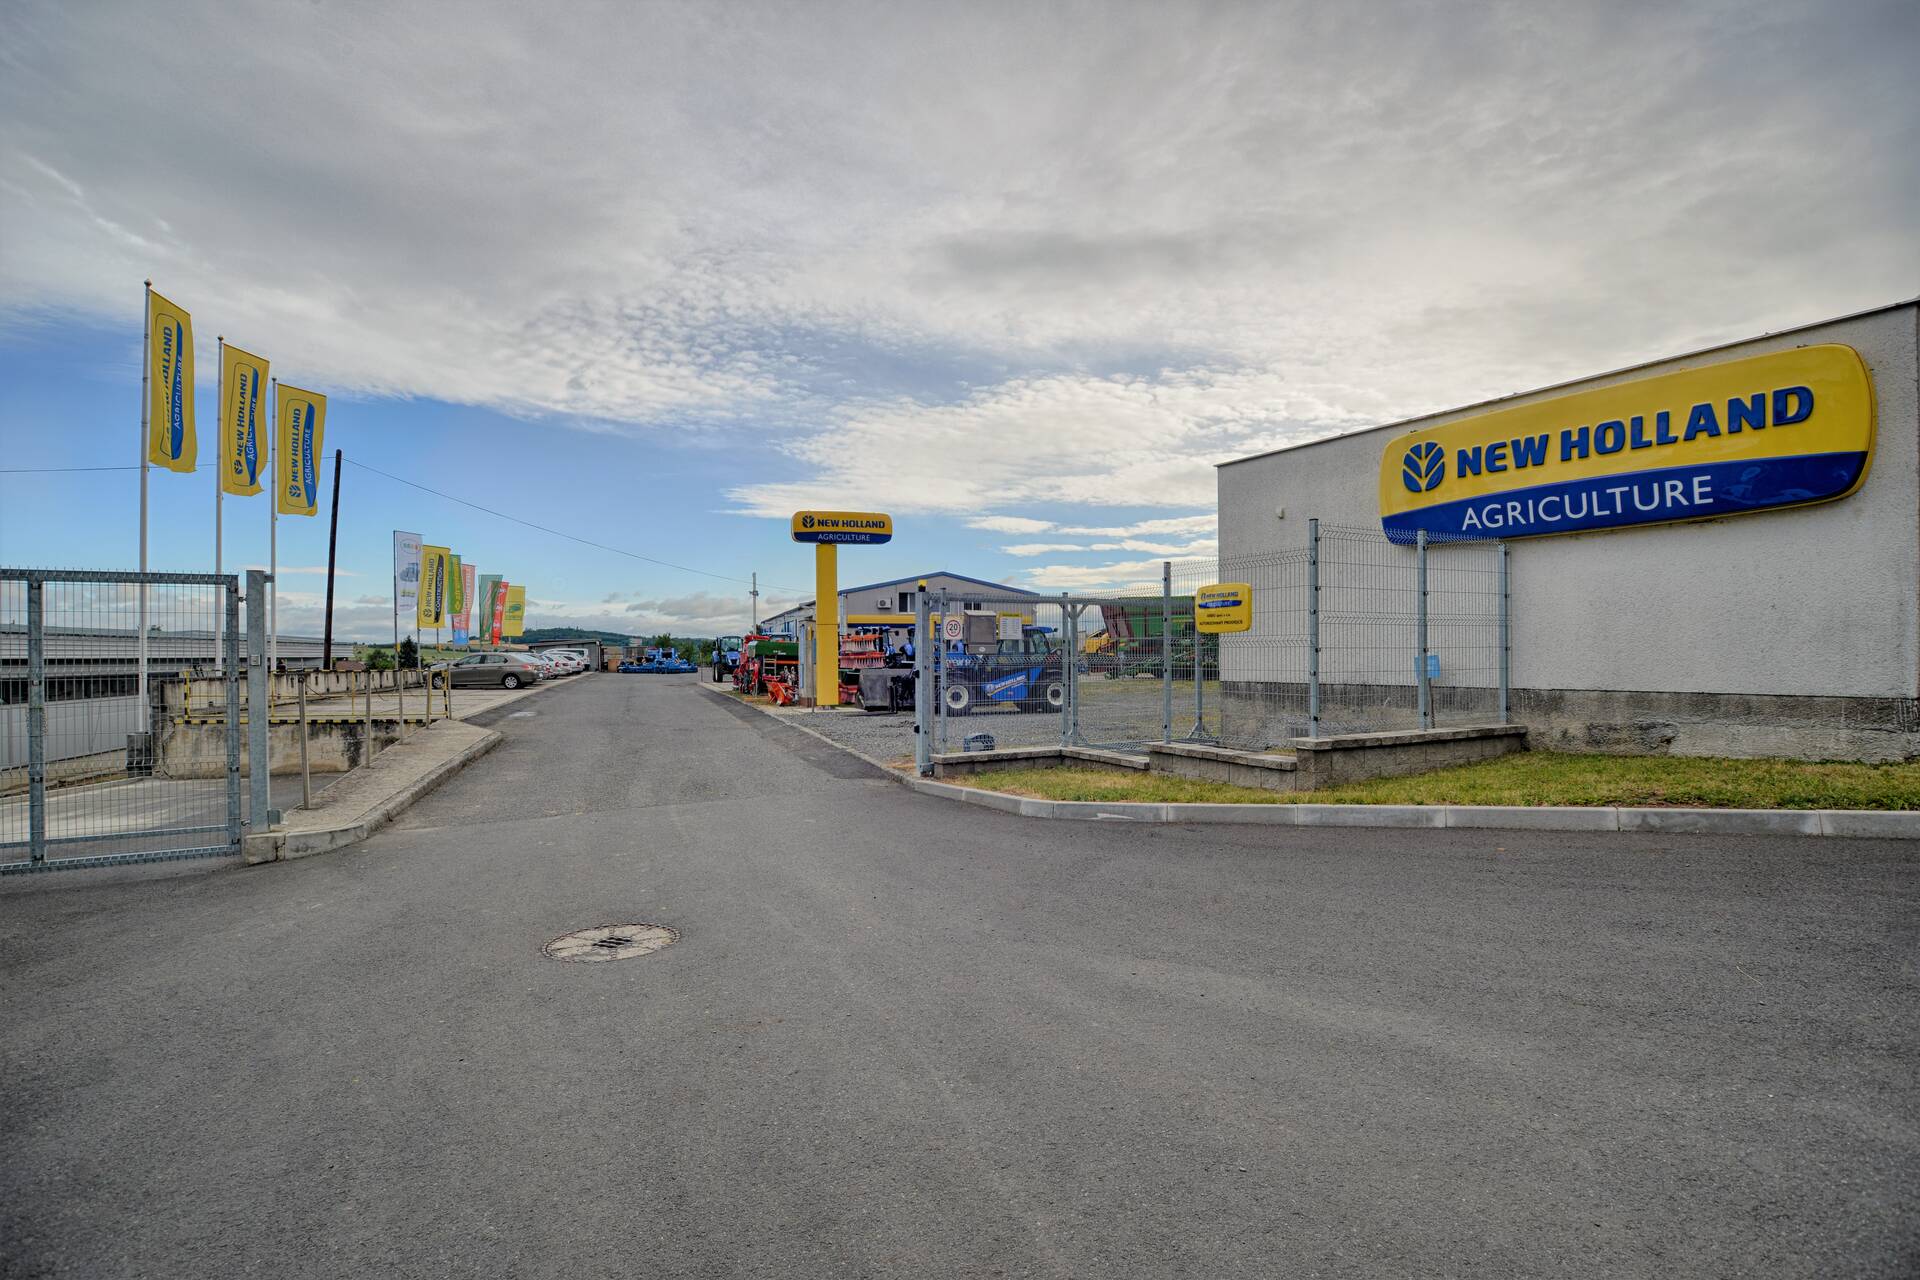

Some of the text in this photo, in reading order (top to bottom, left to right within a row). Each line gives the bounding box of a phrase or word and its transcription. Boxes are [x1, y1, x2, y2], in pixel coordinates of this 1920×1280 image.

[236, 373, 248, 457] NEW HOLLAND
[246, 397, 257, 460] AGRICURE
[1456, 385, 1815, 478] NEW HOLLAND
[291, 408, 301, 482] NEW HOLLAND
[304, 428, 312, 485] AGRICULTURE
[817, 519, 885, 529] NEW HOLLAND
[1462, 475, 1714, 531] AGRICULTURE
[817, 533, 871, 542] AGRICULTURE
[949, 623, 958, 631] 20
